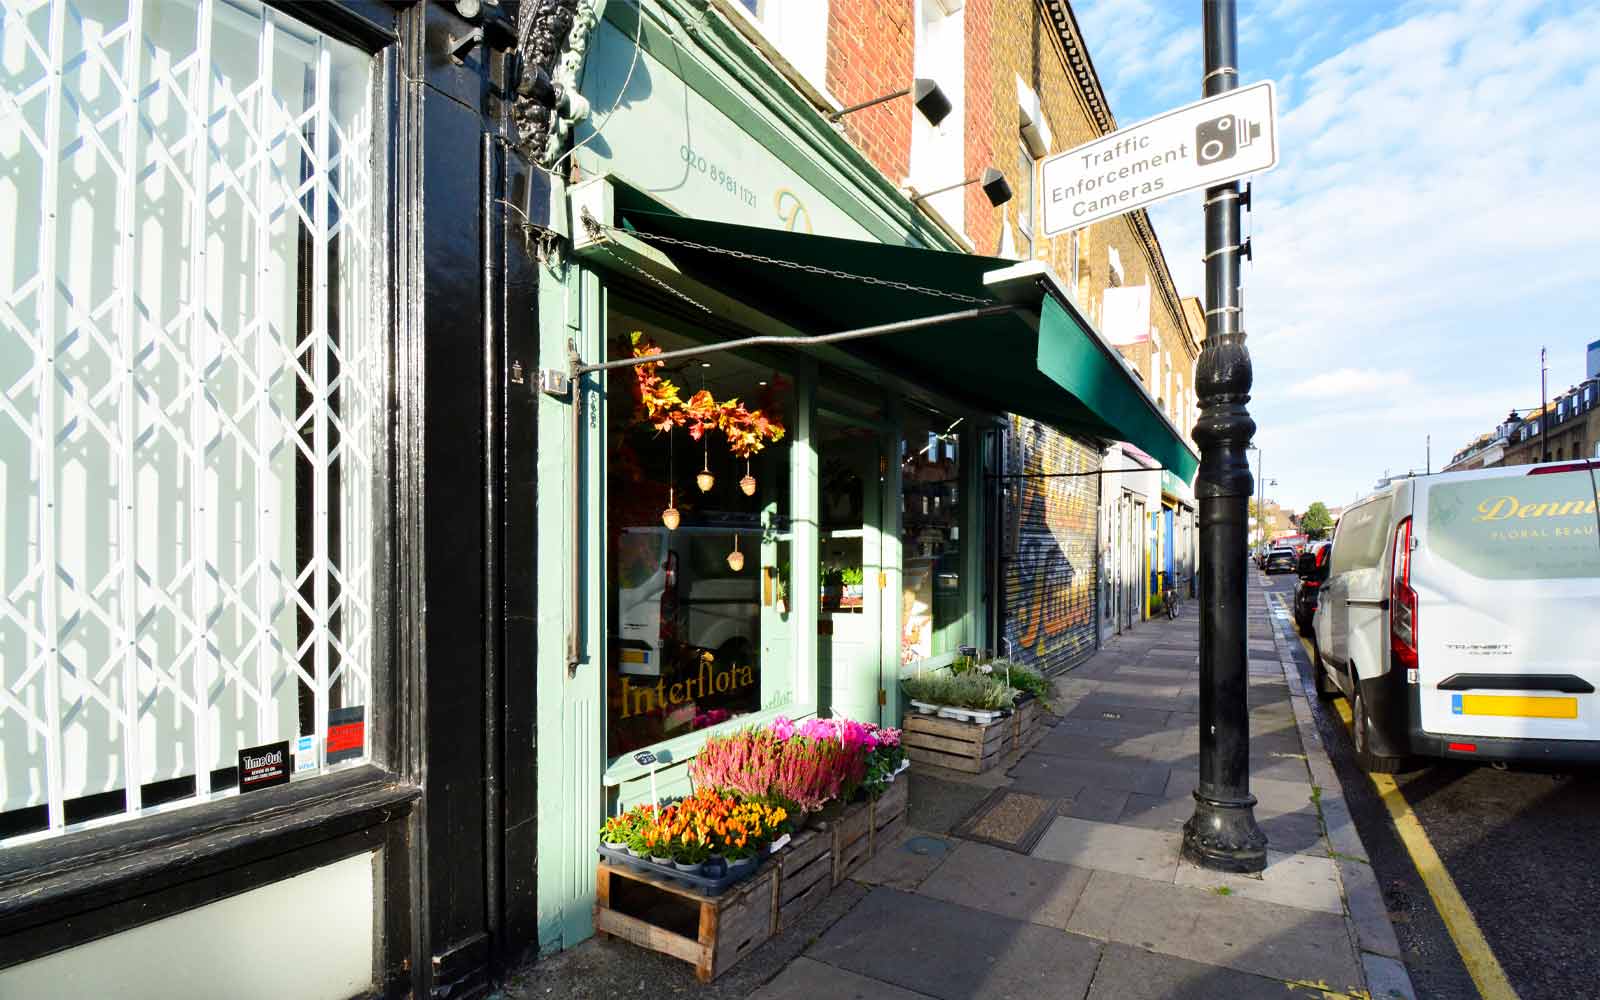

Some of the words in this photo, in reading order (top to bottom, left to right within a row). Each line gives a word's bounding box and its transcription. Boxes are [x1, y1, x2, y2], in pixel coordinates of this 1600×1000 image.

[680, 145, 707, 173] 020
[710, 165, 737, 195] 8981
[740, 184, 757, 209] 1121
[1051, 142, 1188, 203] Enforcement
[1081, 135, 1150, 170] Traffic
[1072, 177, 1165, 218] Cameras
[619, 662, 754, 719] Interflora
